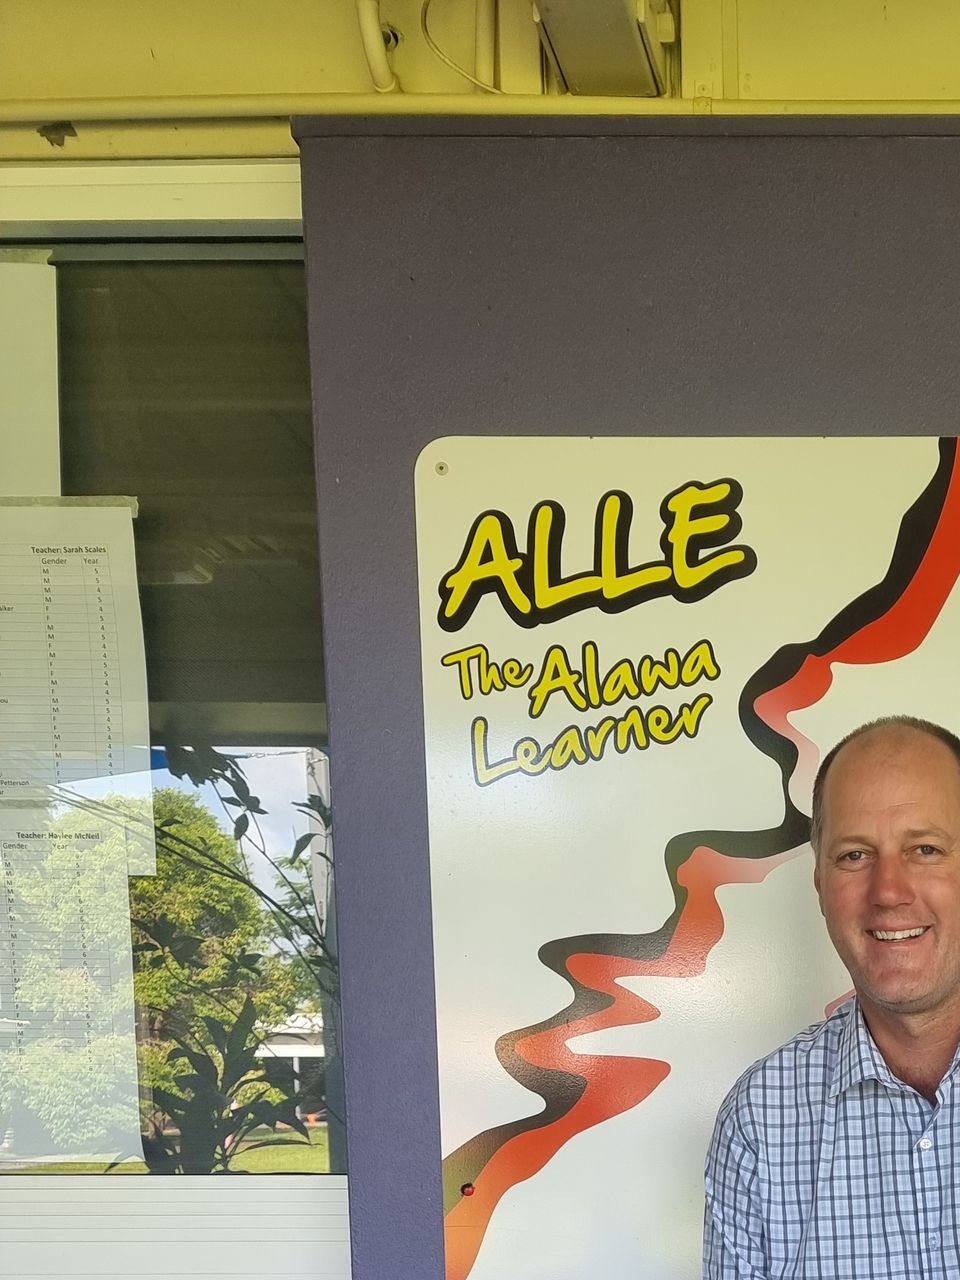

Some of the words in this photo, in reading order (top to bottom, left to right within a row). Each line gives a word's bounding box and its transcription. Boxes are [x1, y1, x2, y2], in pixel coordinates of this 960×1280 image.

[438, 478, 757, 631] ALLE
[442, 645, 533, 699] The
[529, 639, 721, 718] Alawa
[472, 693, 713, 786] Learner
